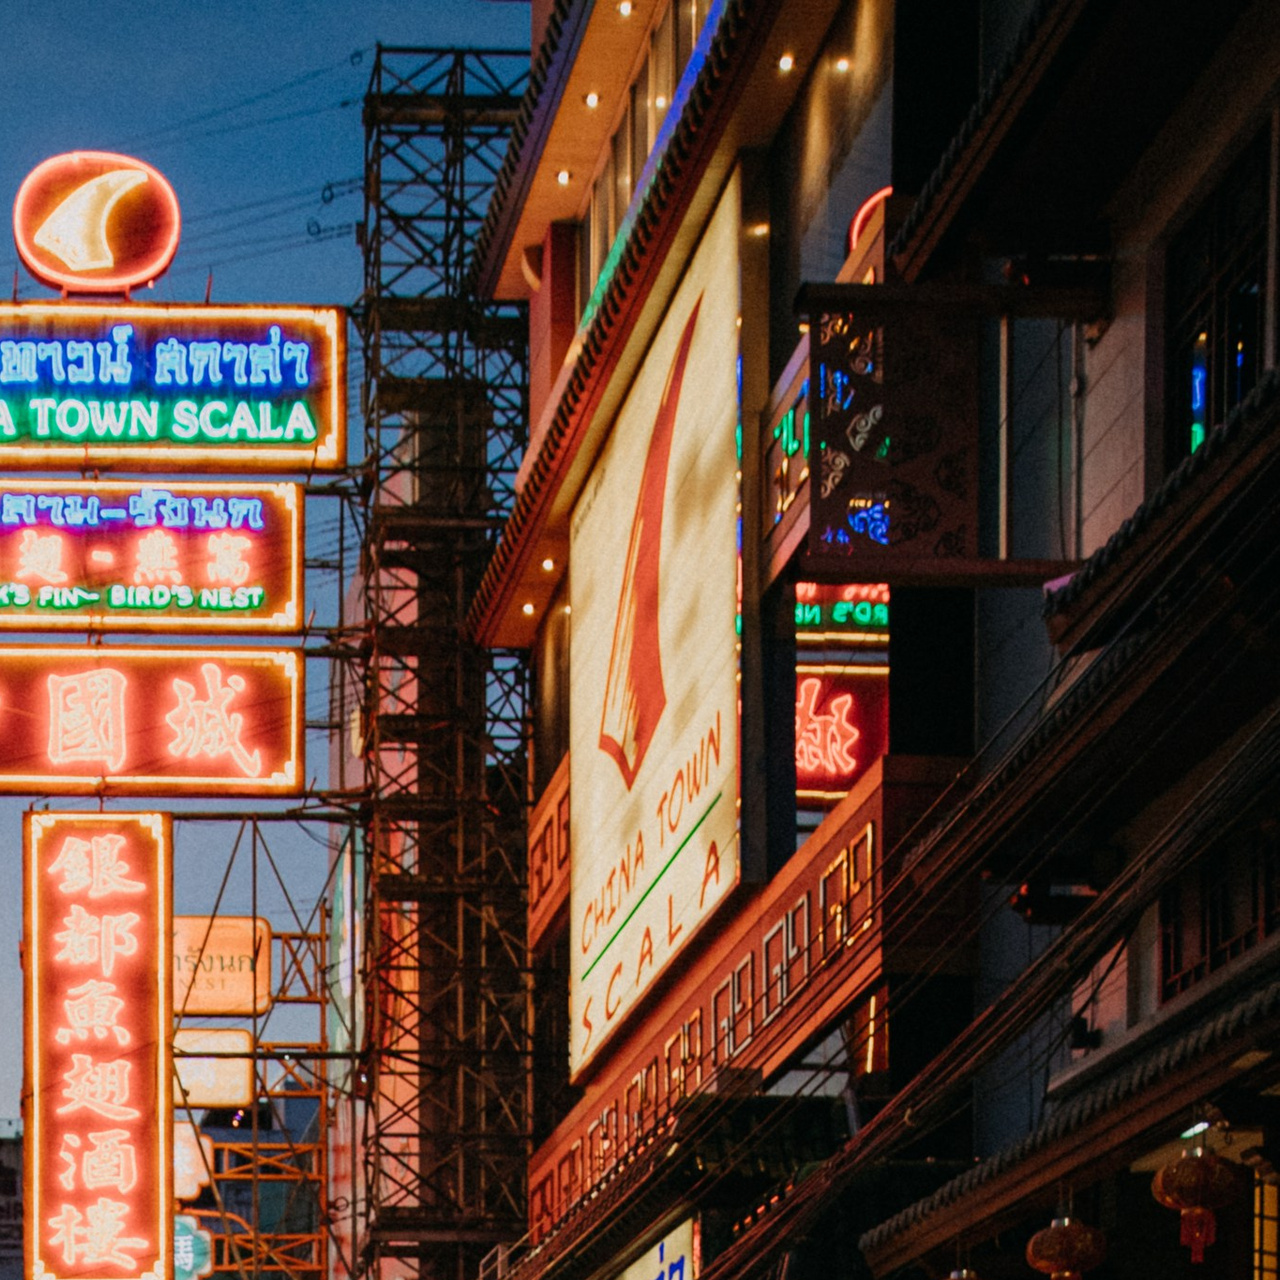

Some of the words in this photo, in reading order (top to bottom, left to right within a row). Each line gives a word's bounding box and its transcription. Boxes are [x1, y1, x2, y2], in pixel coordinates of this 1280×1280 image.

[29, 399, 158, 438] TOWN
[172, 401, 317, 441] SCALA
[154, 327, 310, 385] สกาล่า
[107, 584, 194, 607] BIRD'S
[200, 586, 264, 608] NEST
[581, 830, 644, 955] CHINA
[657, 710, 720, 849] TOWN
[581, 840, 721, 1054] SCALA
[48, 832, 149, 1271] 銀都魚翅酒樓
